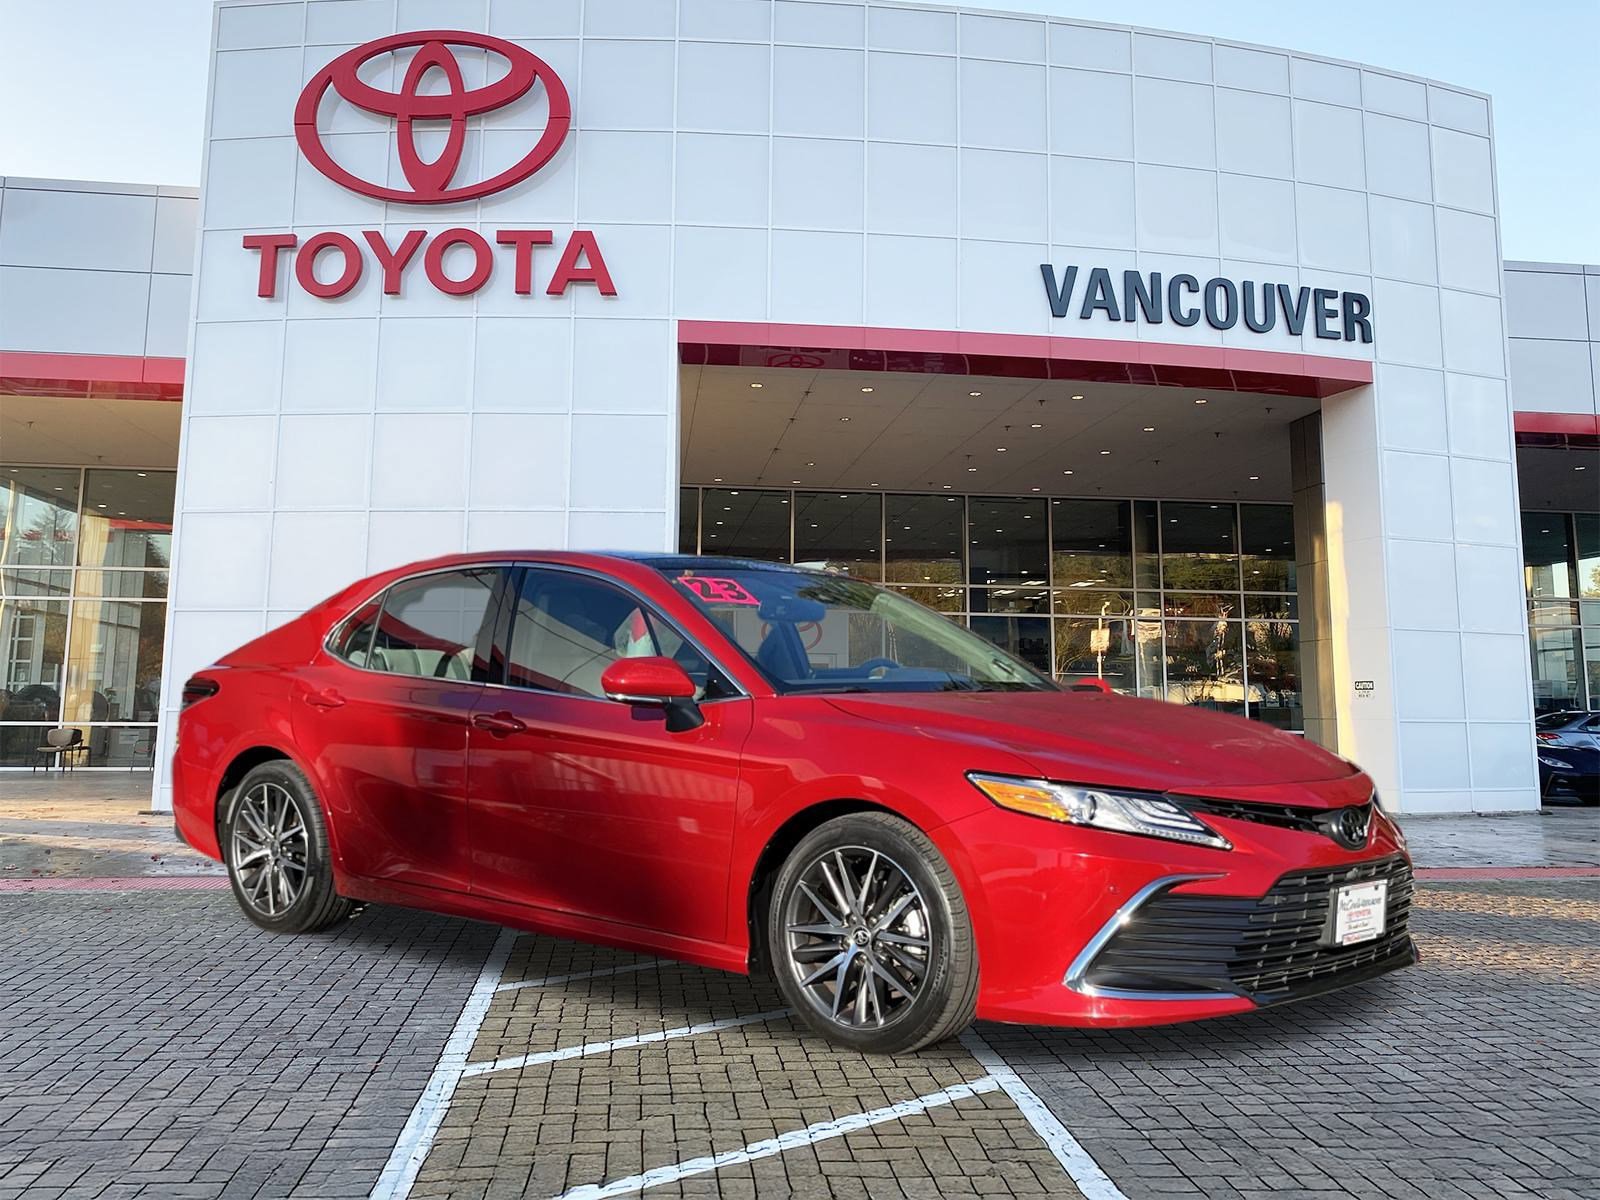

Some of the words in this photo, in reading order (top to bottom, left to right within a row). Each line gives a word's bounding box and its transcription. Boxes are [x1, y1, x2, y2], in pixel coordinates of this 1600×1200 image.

[242, 228, 618, 299] TOYOTA
[1040, 264, 1373, 343] VANCOUVER
[684, 579, 748, 600] 23
